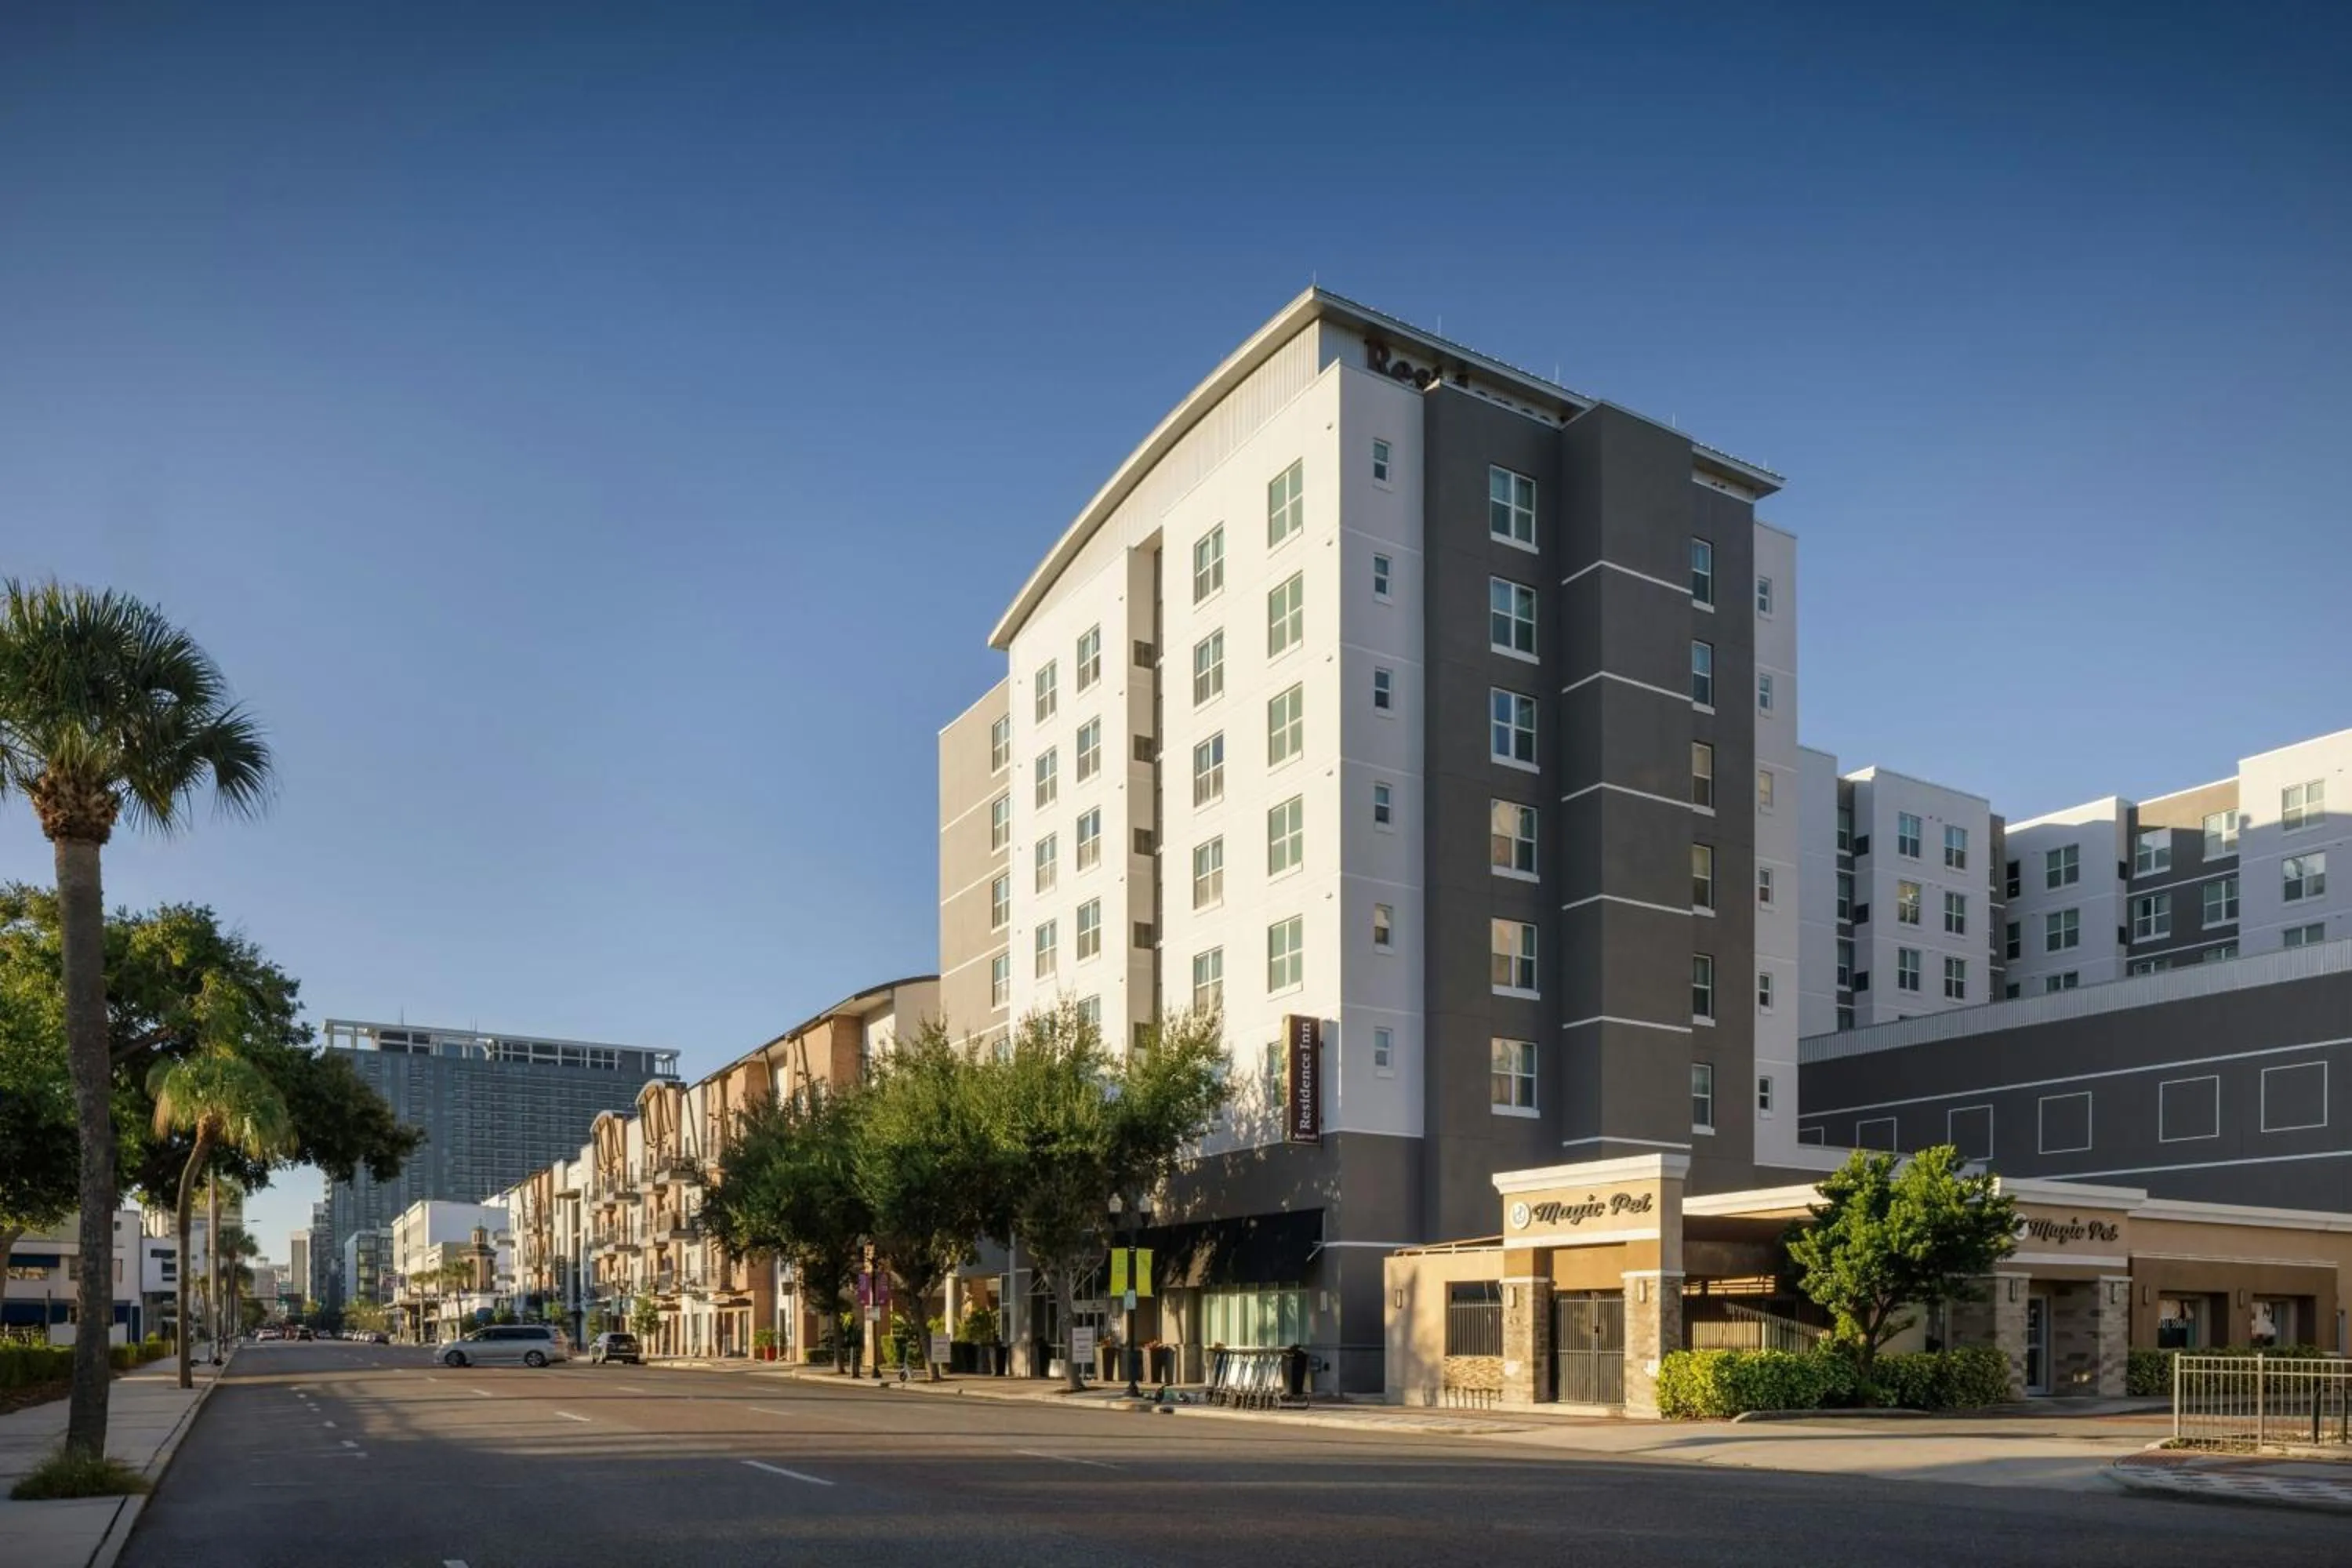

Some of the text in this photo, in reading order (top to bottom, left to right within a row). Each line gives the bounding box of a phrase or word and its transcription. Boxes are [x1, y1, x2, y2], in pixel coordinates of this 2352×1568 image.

[1299, 1022, 1312, 1050] Inn
[1299, 1053, 1312, 1130] Residence
[1533, 1192, 1652, 1225] Magic Pet
[2027, 1217, 2118, 1244] Magic Pet
